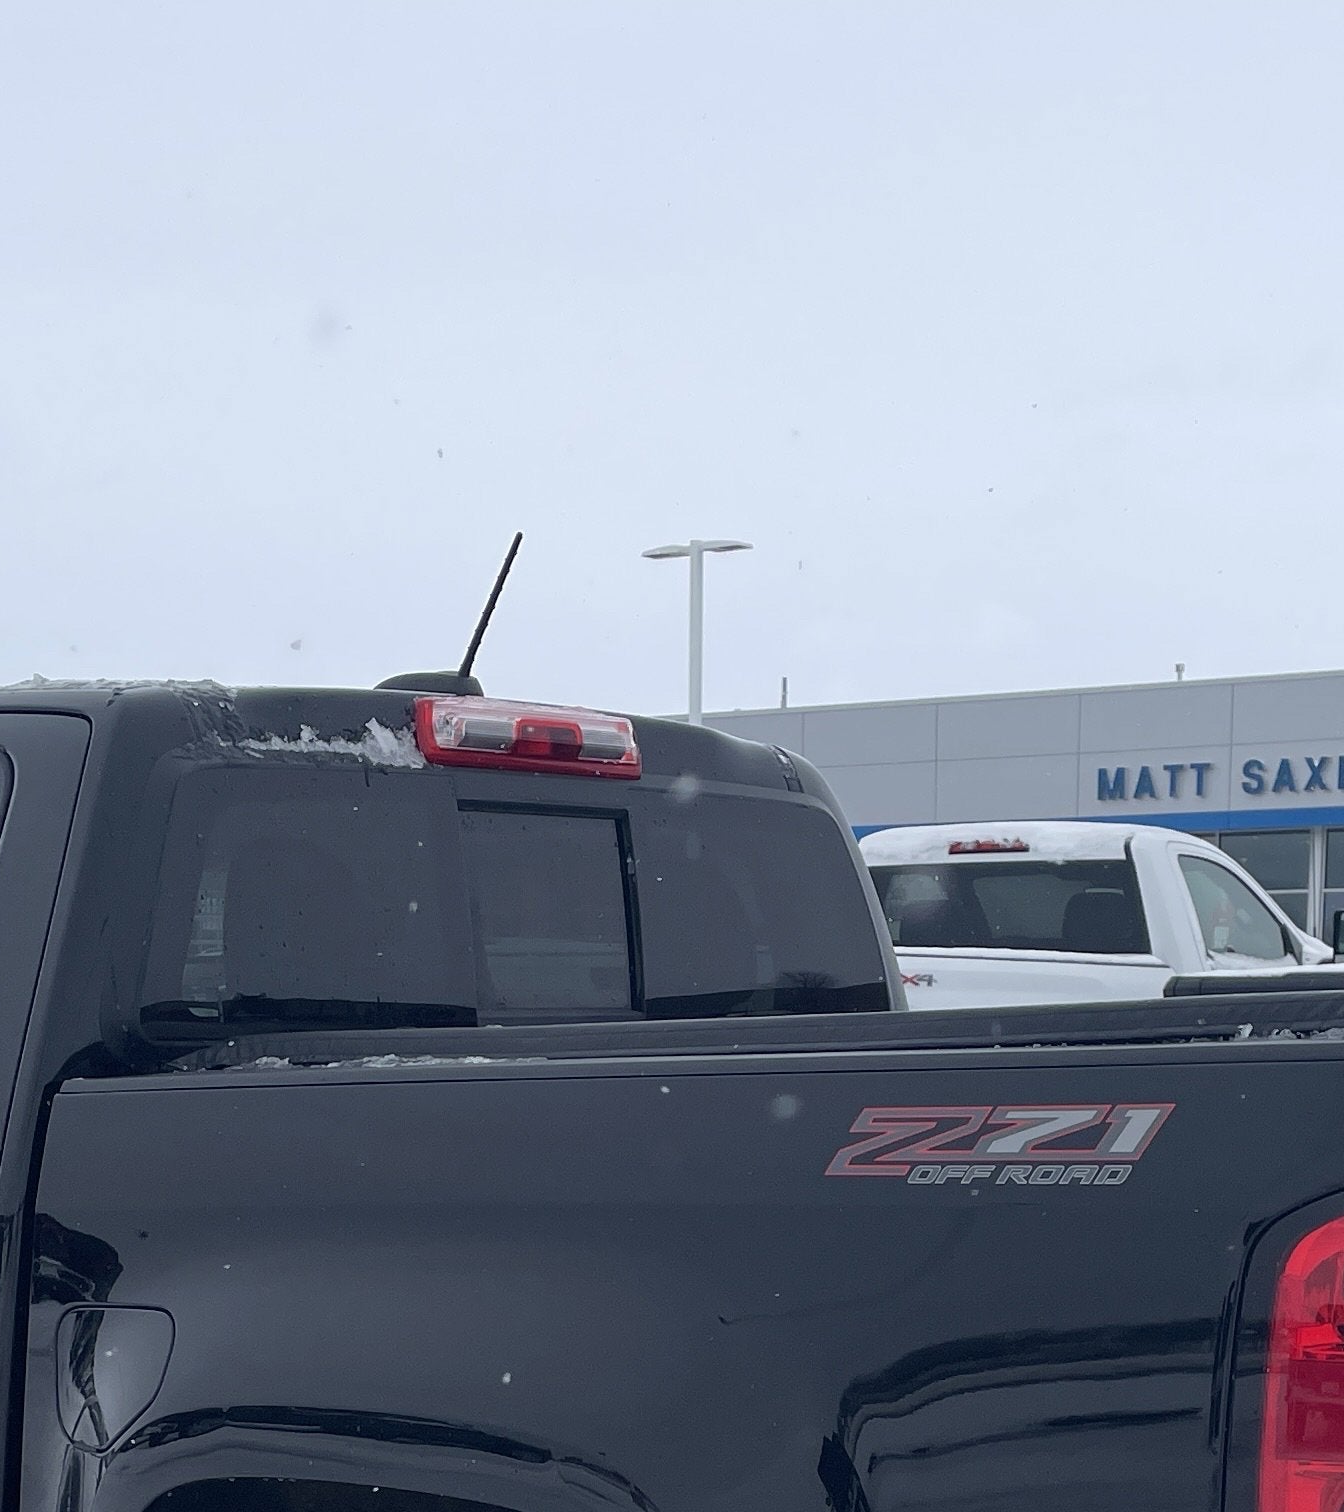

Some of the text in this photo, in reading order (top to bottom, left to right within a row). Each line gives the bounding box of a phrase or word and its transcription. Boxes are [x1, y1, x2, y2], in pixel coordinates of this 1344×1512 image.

[1097, 762, 1211, 801] MATT
[824, 1103, 1176, 1176] Z71
[906, 1164, 1133, 1185] OFF ROAD
